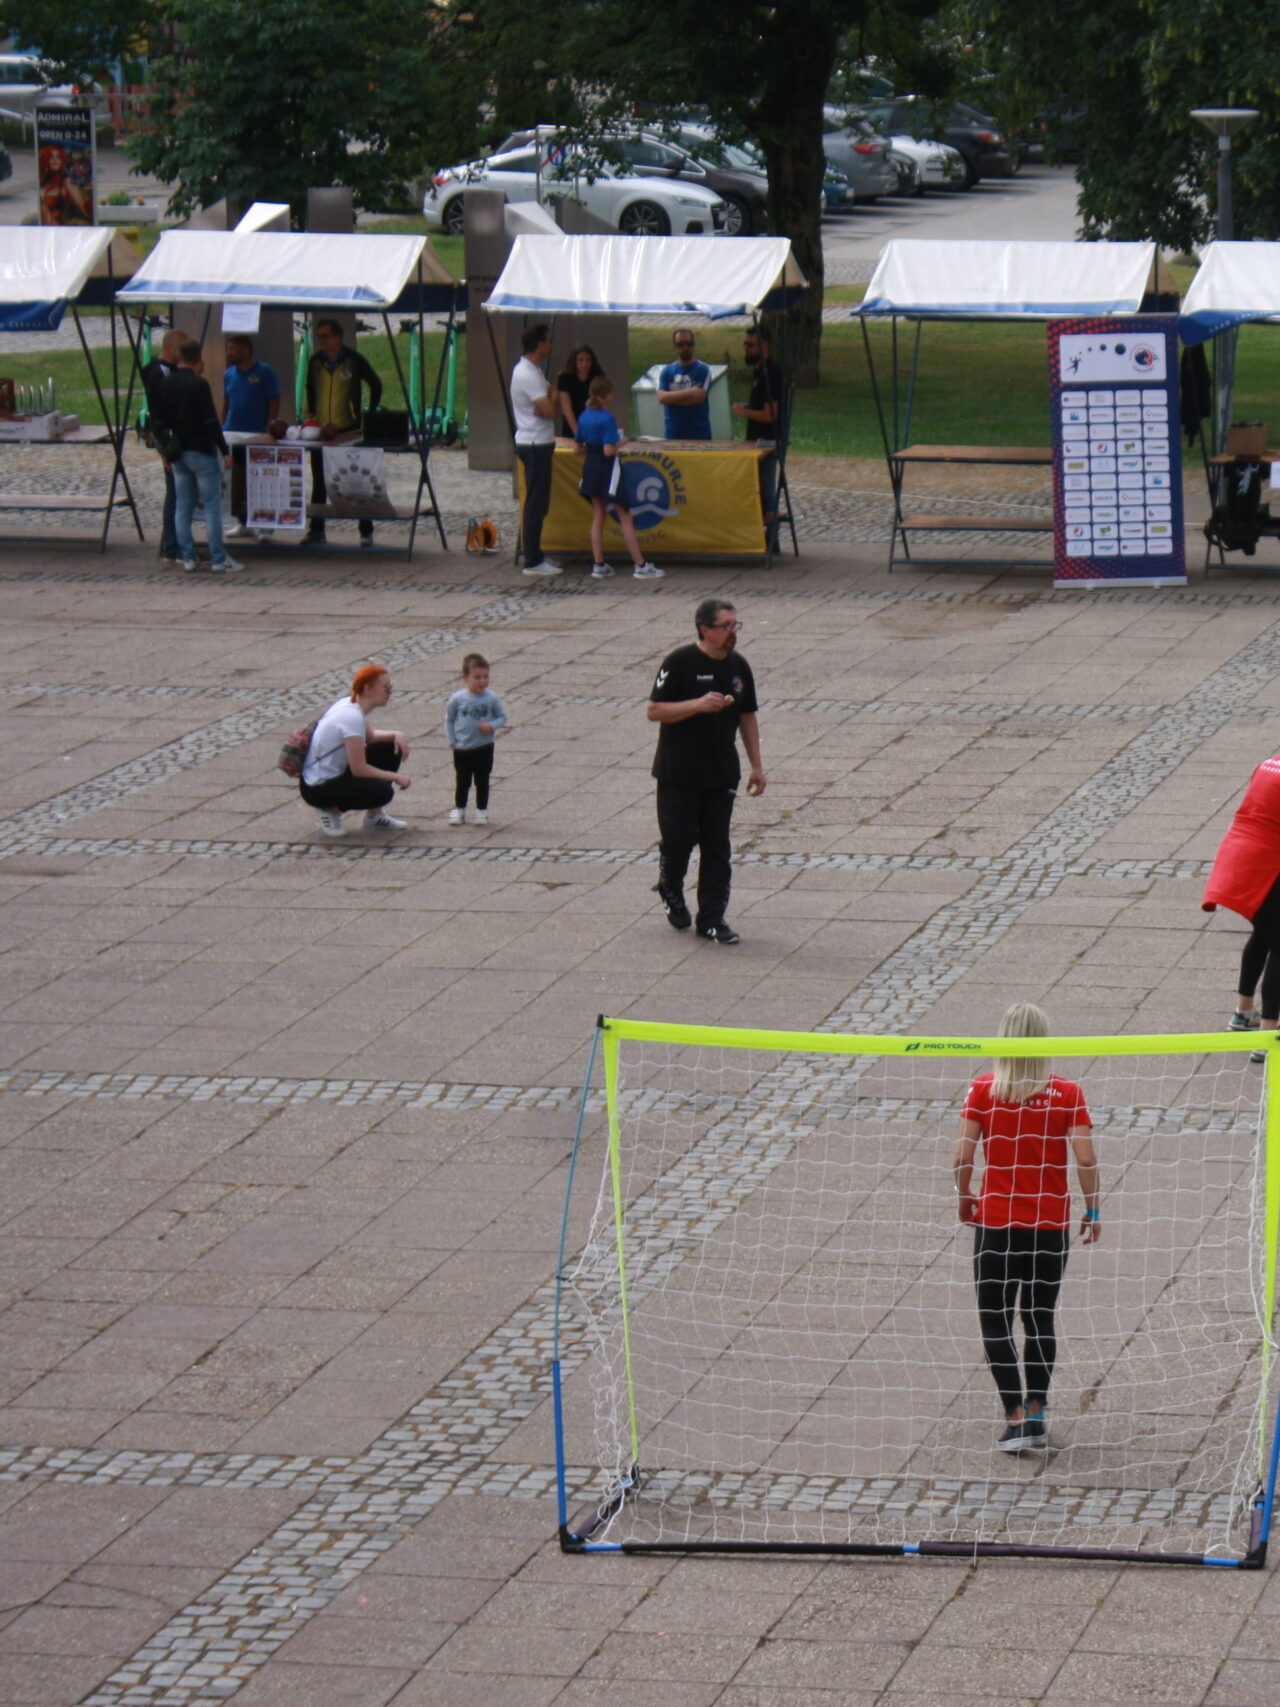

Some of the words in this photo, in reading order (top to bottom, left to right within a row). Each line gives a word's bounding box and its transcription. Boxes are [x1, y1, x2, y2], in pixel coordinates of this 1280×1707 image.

[37, 111, 89, 121] ADMIRAL
[39, 130, 63, 139] OPEN
[65, 130, 88, 139] 0-24
